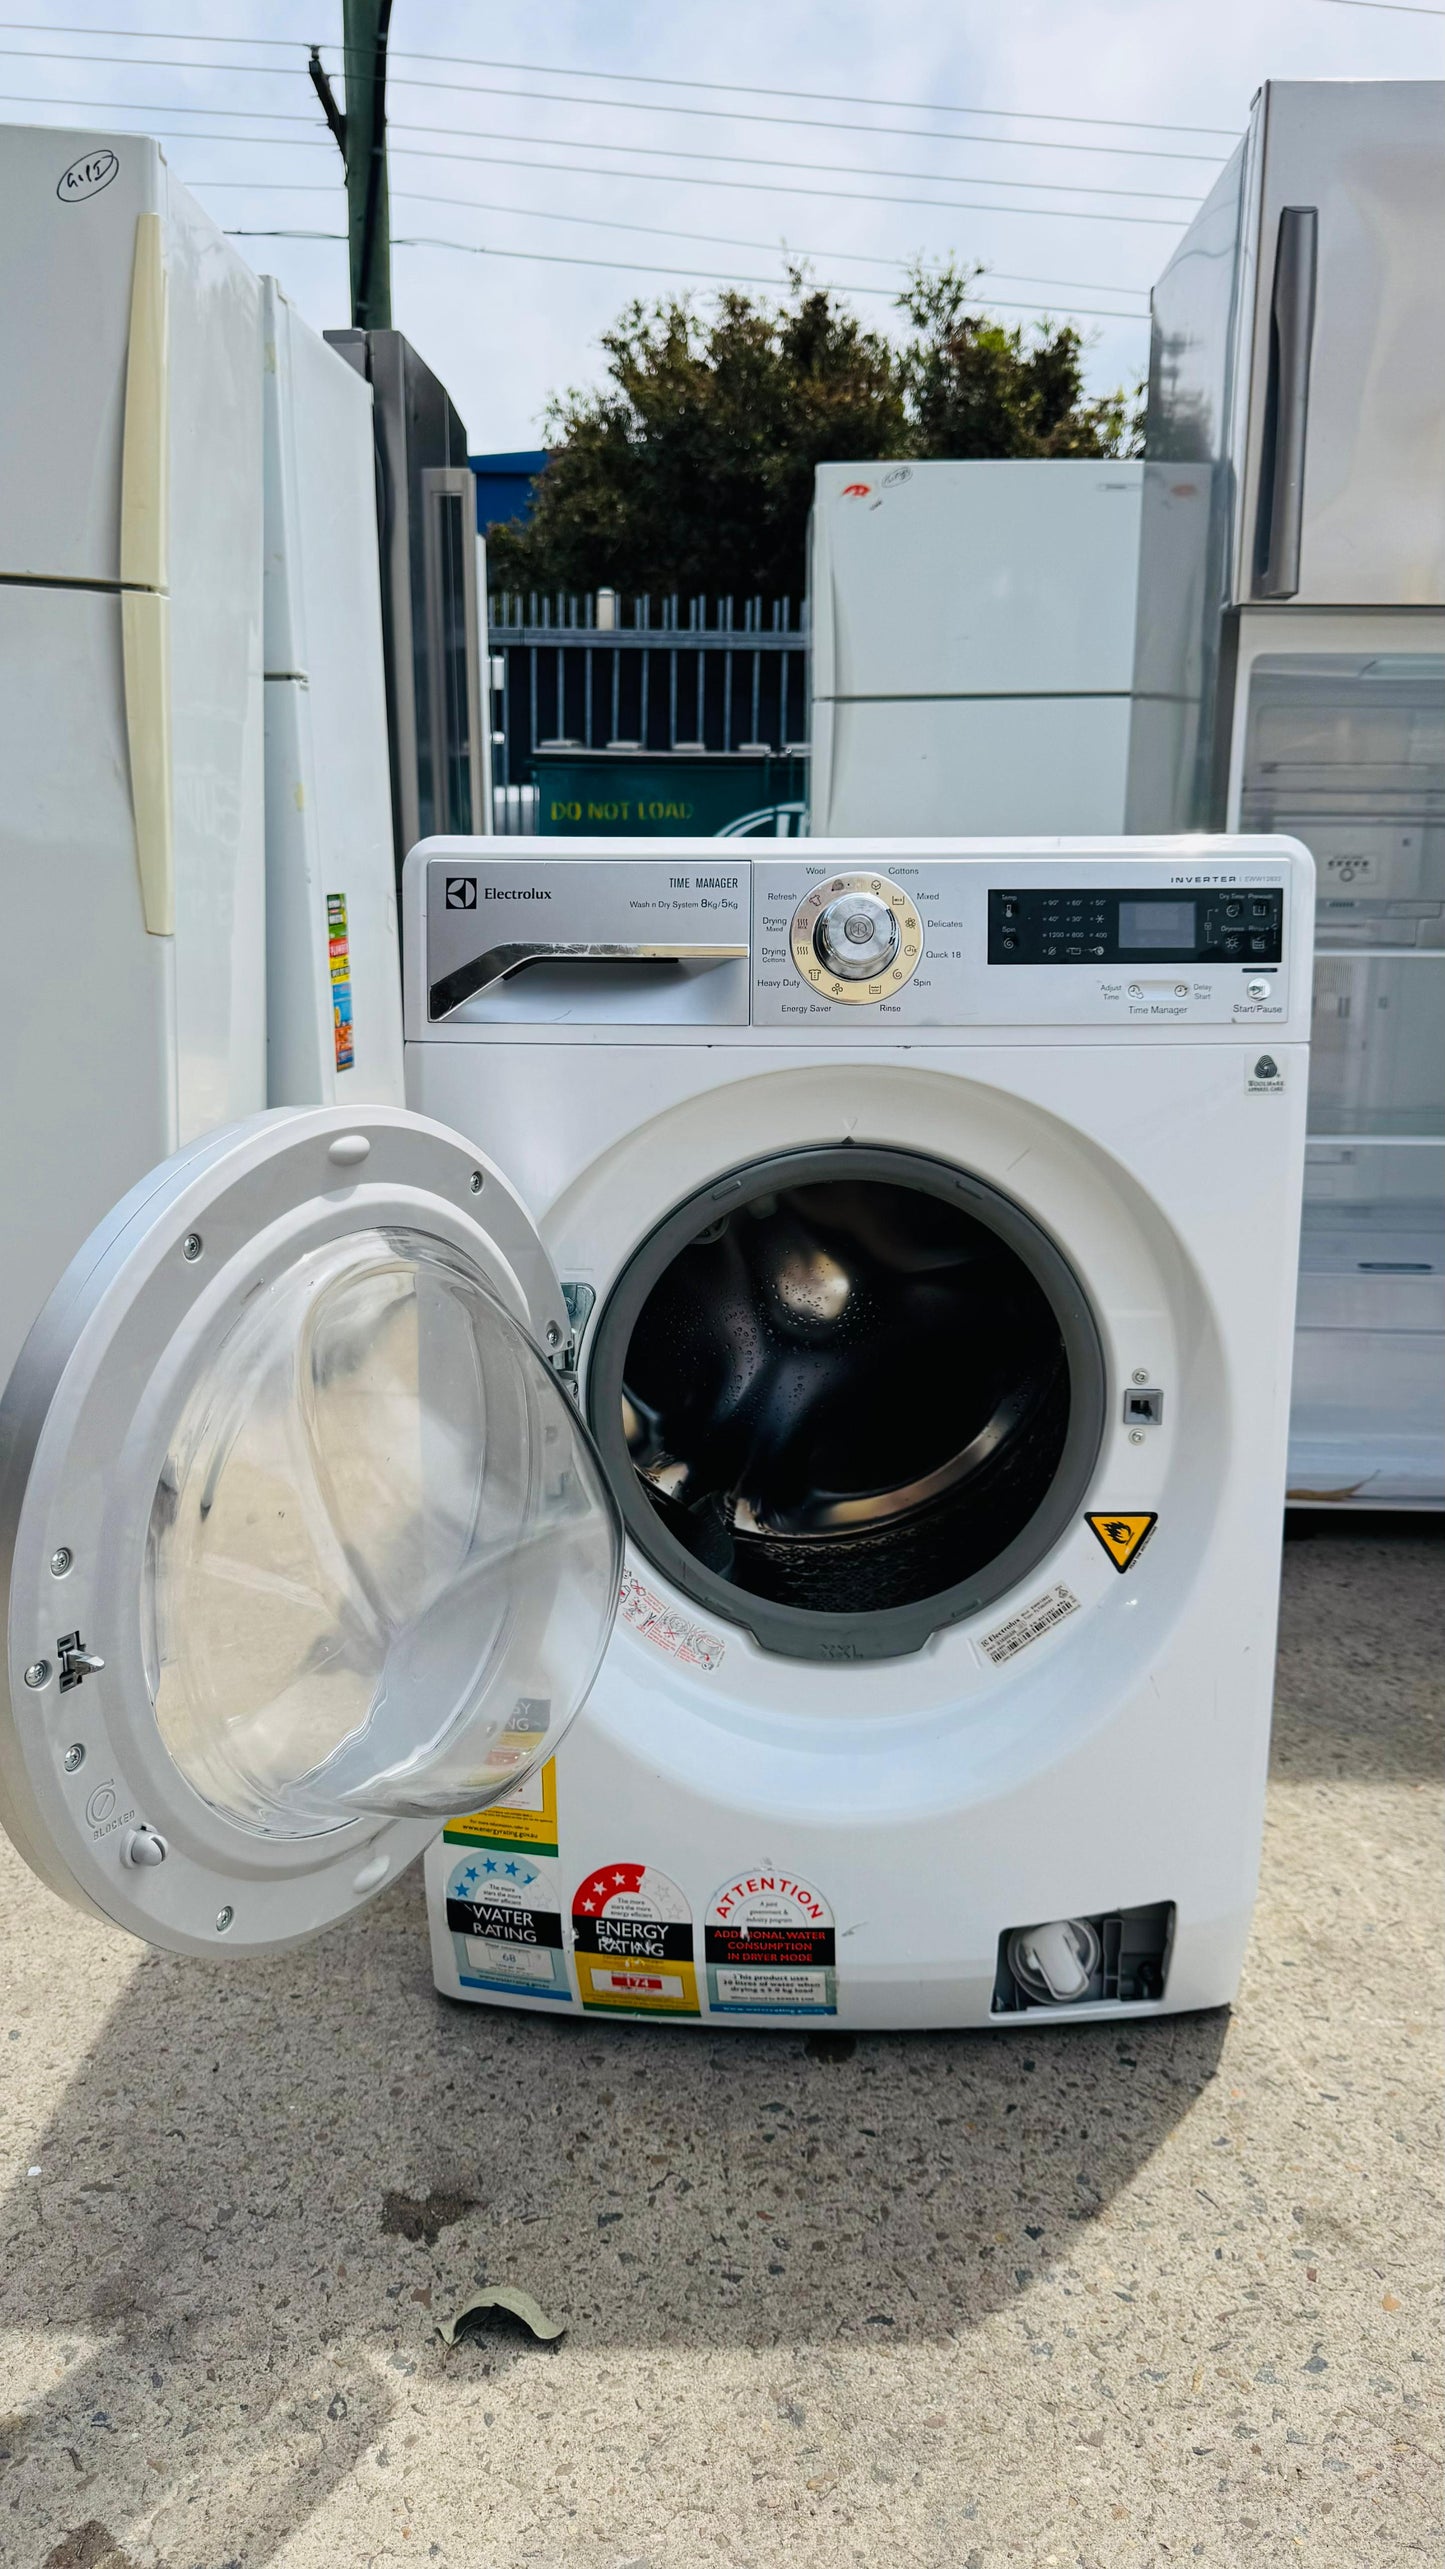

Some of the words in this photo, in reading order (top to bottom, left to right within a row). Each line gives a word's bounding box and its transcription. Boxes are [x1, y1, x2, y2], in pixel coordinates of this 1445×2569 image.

[551, 803, 581, 821] DO
[588, 802, 629, 820] NOT
[638, 802, 693, 820] LOAD
[806, 867, 826, 875] Wool
[888, 867, 919, 875] Cottons
[669, 878, 690, 888] TIME
[696, 878, 738, 888] MANAGER
[485, 888, 552, 900] Electrolux
[658, 901, 671, 909] Dry
[672, 901, 699, 909] System
[762, 917, 787, 925] Drying
[928, 920, 963, 928] Delicates
[761, 948, 786, 956] Drying
[926, 951, 948, 959] Quick
[757, 980, 781, 988] Heavy
[783, 979, 800, 988] Duty
[913, 979, 931, 988] Spin
[1101, 984, 1121, 992] Adjust
[1194, 984, 1212, 992] Delay
[781, 1005, 807, 1014] Energy
[1129, 1006, 1148, 1014] Time
[1151, 1006, 1188, 1016] Manager
[1233, 1005, 1282, 1013] Start/Pause
[93, 1809, 135, 1840] BLOCKED
[716, 1877, 824, 1919] ATTENTION
[473, 1905, 534, 1927] WATER
[473, 1923, 537, 1942] RATING
[595, 1920, 669, 1940] ENERGY
[786, 1931, 826, 1940] WATER
[598, 1938, 665, 1957] RATING
[727, 1941, 813, 1951] CONSUMPTION
[727, 1953, 740, 1961] IN
[742, 1953, 777, 1962] DRYER
[780, 1954, 813, 1962] MODE
